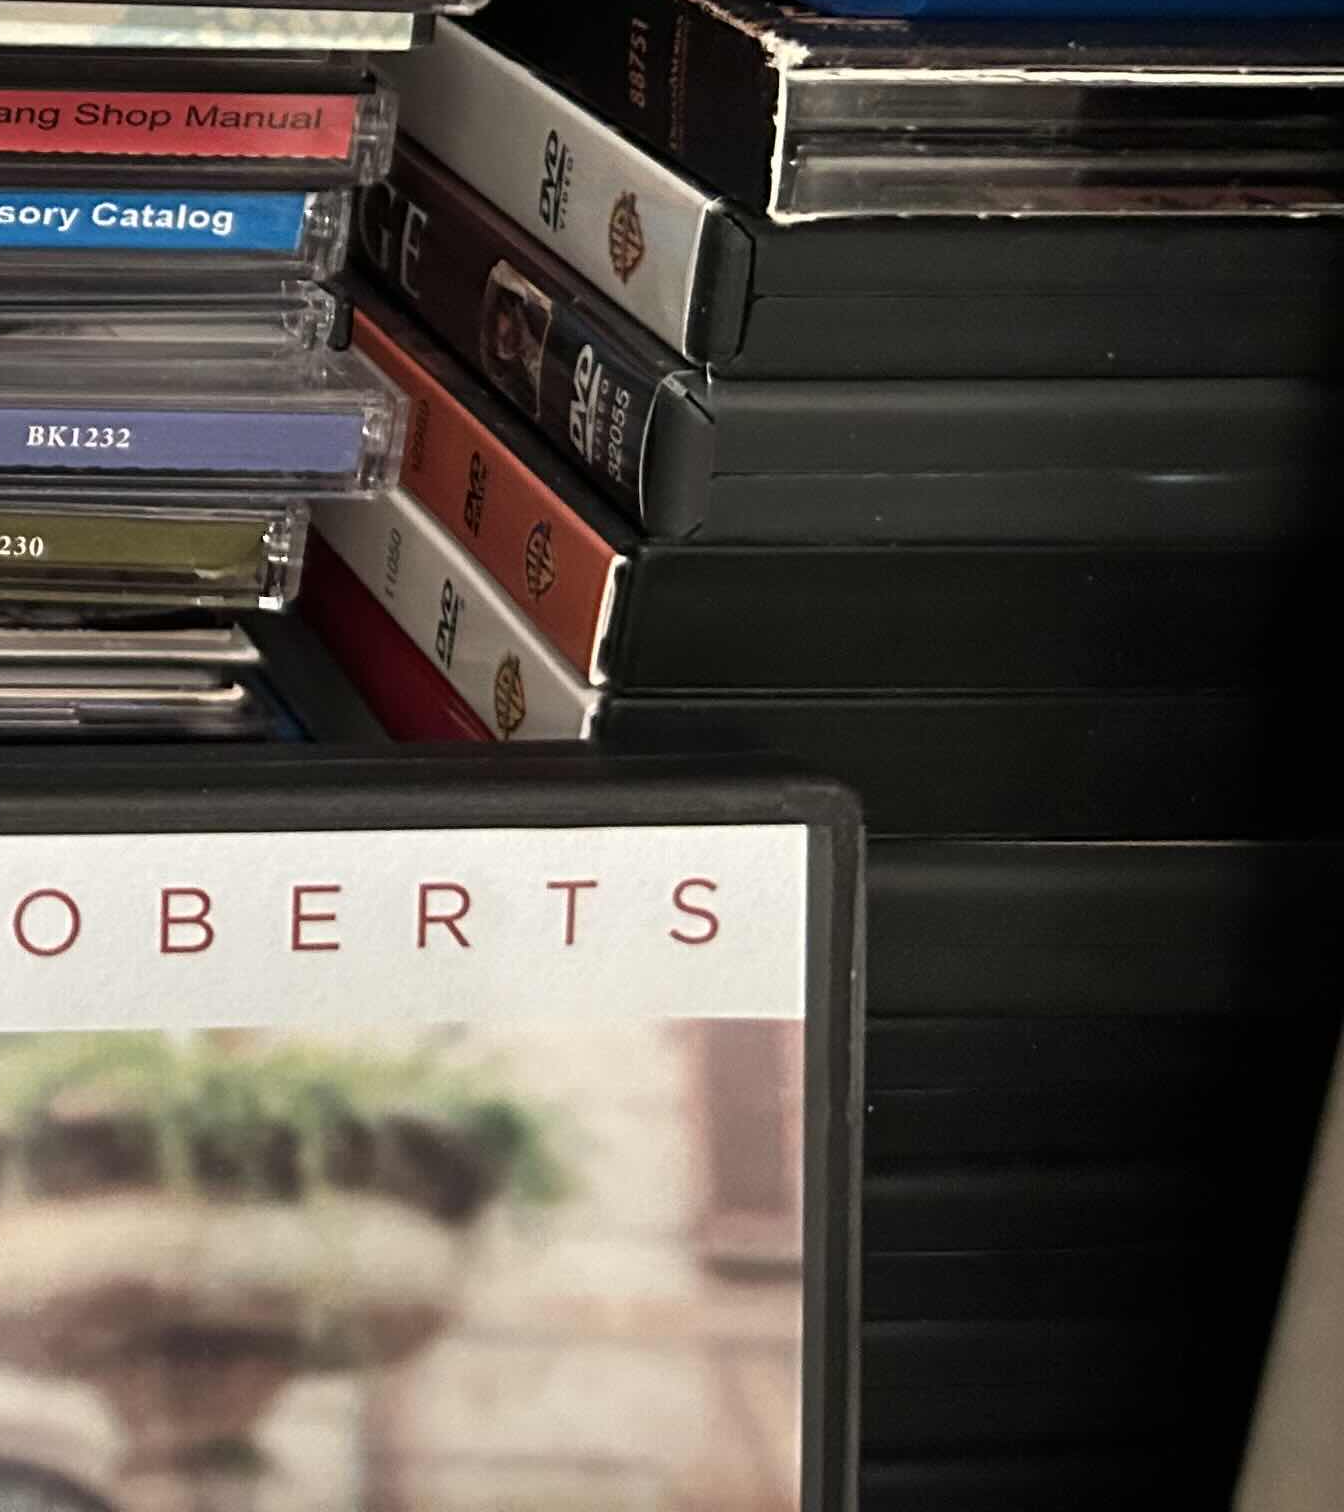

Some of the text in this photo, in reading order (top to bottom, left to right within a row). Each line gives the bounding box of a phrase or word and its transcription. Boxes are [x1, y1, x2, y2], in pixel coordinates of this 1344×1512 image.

[74, 102, 171, 133] Shop
[184, 104, 323, 131] Manual
[539, 129, 561, 225] DVD
[91, 201, 235, 236] Catalog
[568, 343, 594, 457] DVD
[26, 425, 132, 449] BK1232
